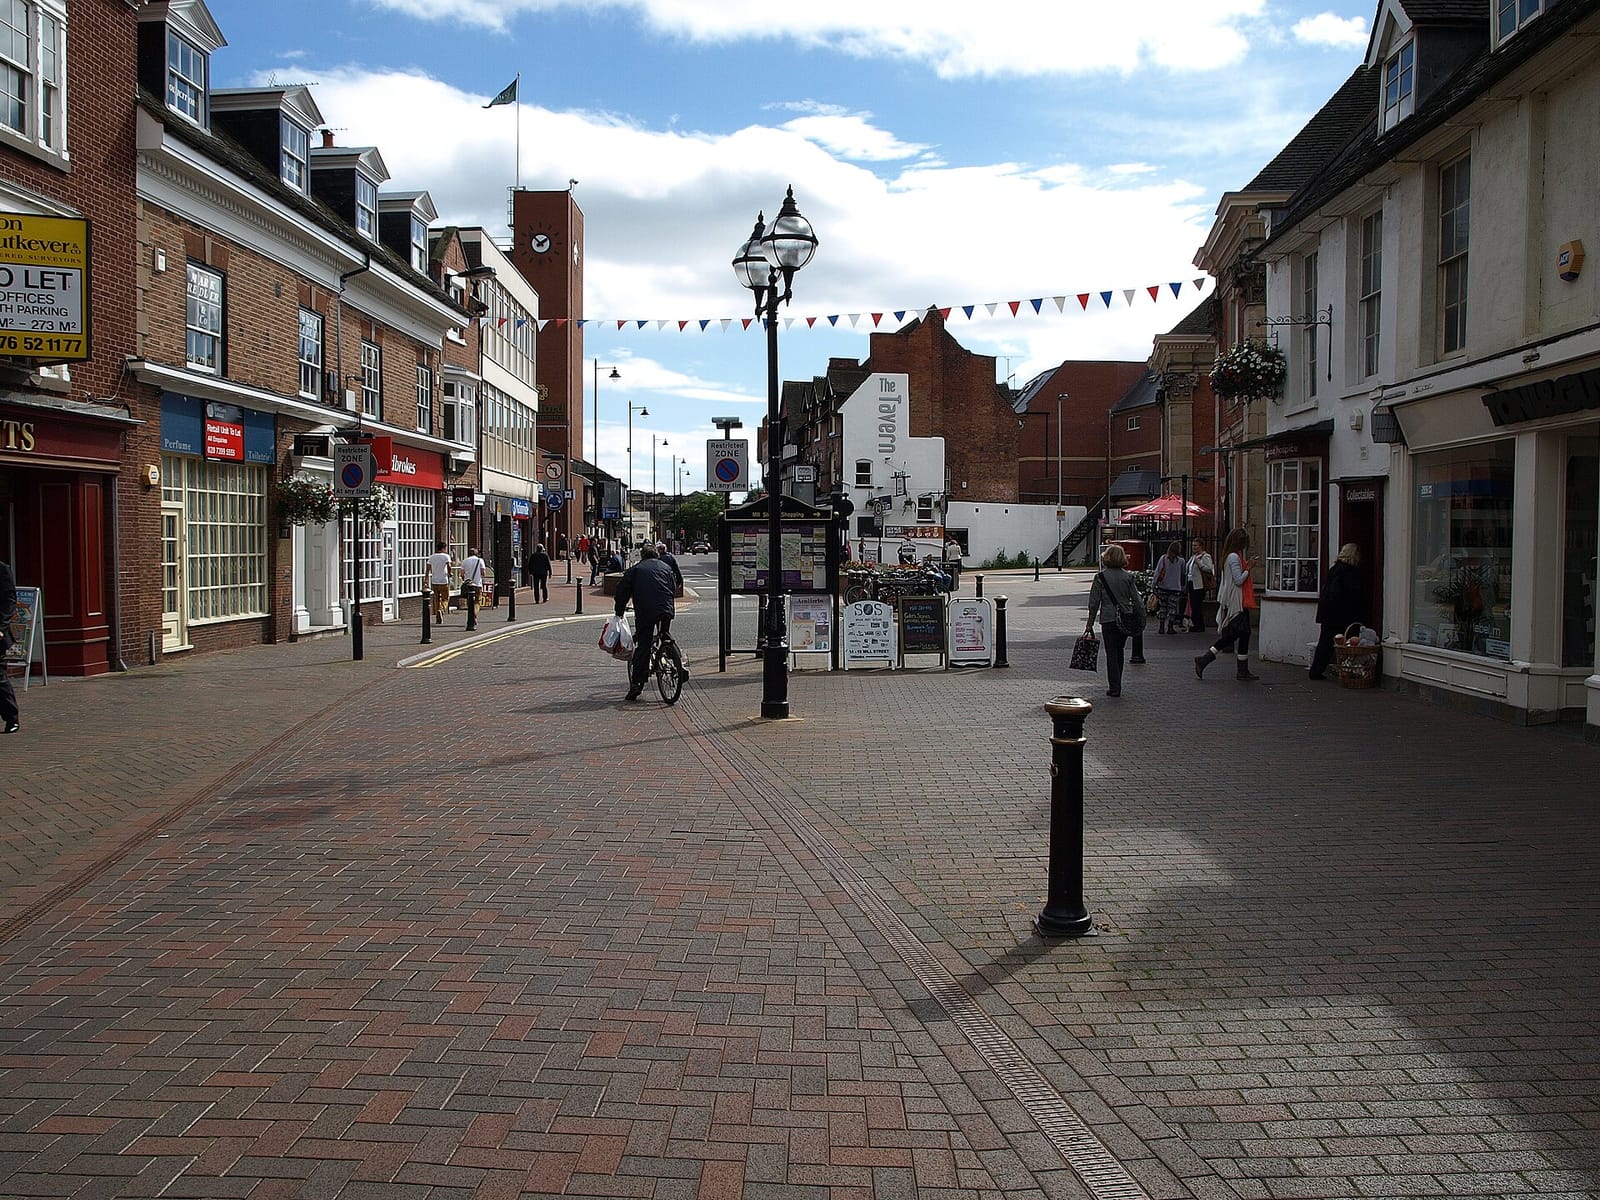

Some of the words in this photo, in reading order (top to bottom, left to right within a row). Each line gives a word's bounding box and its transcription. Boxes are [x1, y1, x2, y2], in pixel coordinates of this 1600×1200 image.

[28, 255, 81, 264] SURVEYORS
[24, 269, 73, 291] LET
[0, 290, 55, 305] OFFICES
[17, 304, 68, 317] PARKING
[31, 320, 54, 331] 273
[879, 377, 896, 393] The
[878, 394, 902, 454] Tavern
[164, 438, 192, 451] Perfume
[341, 455, 364, 463] ZONE
[854, 603, 883, 616] SOS
